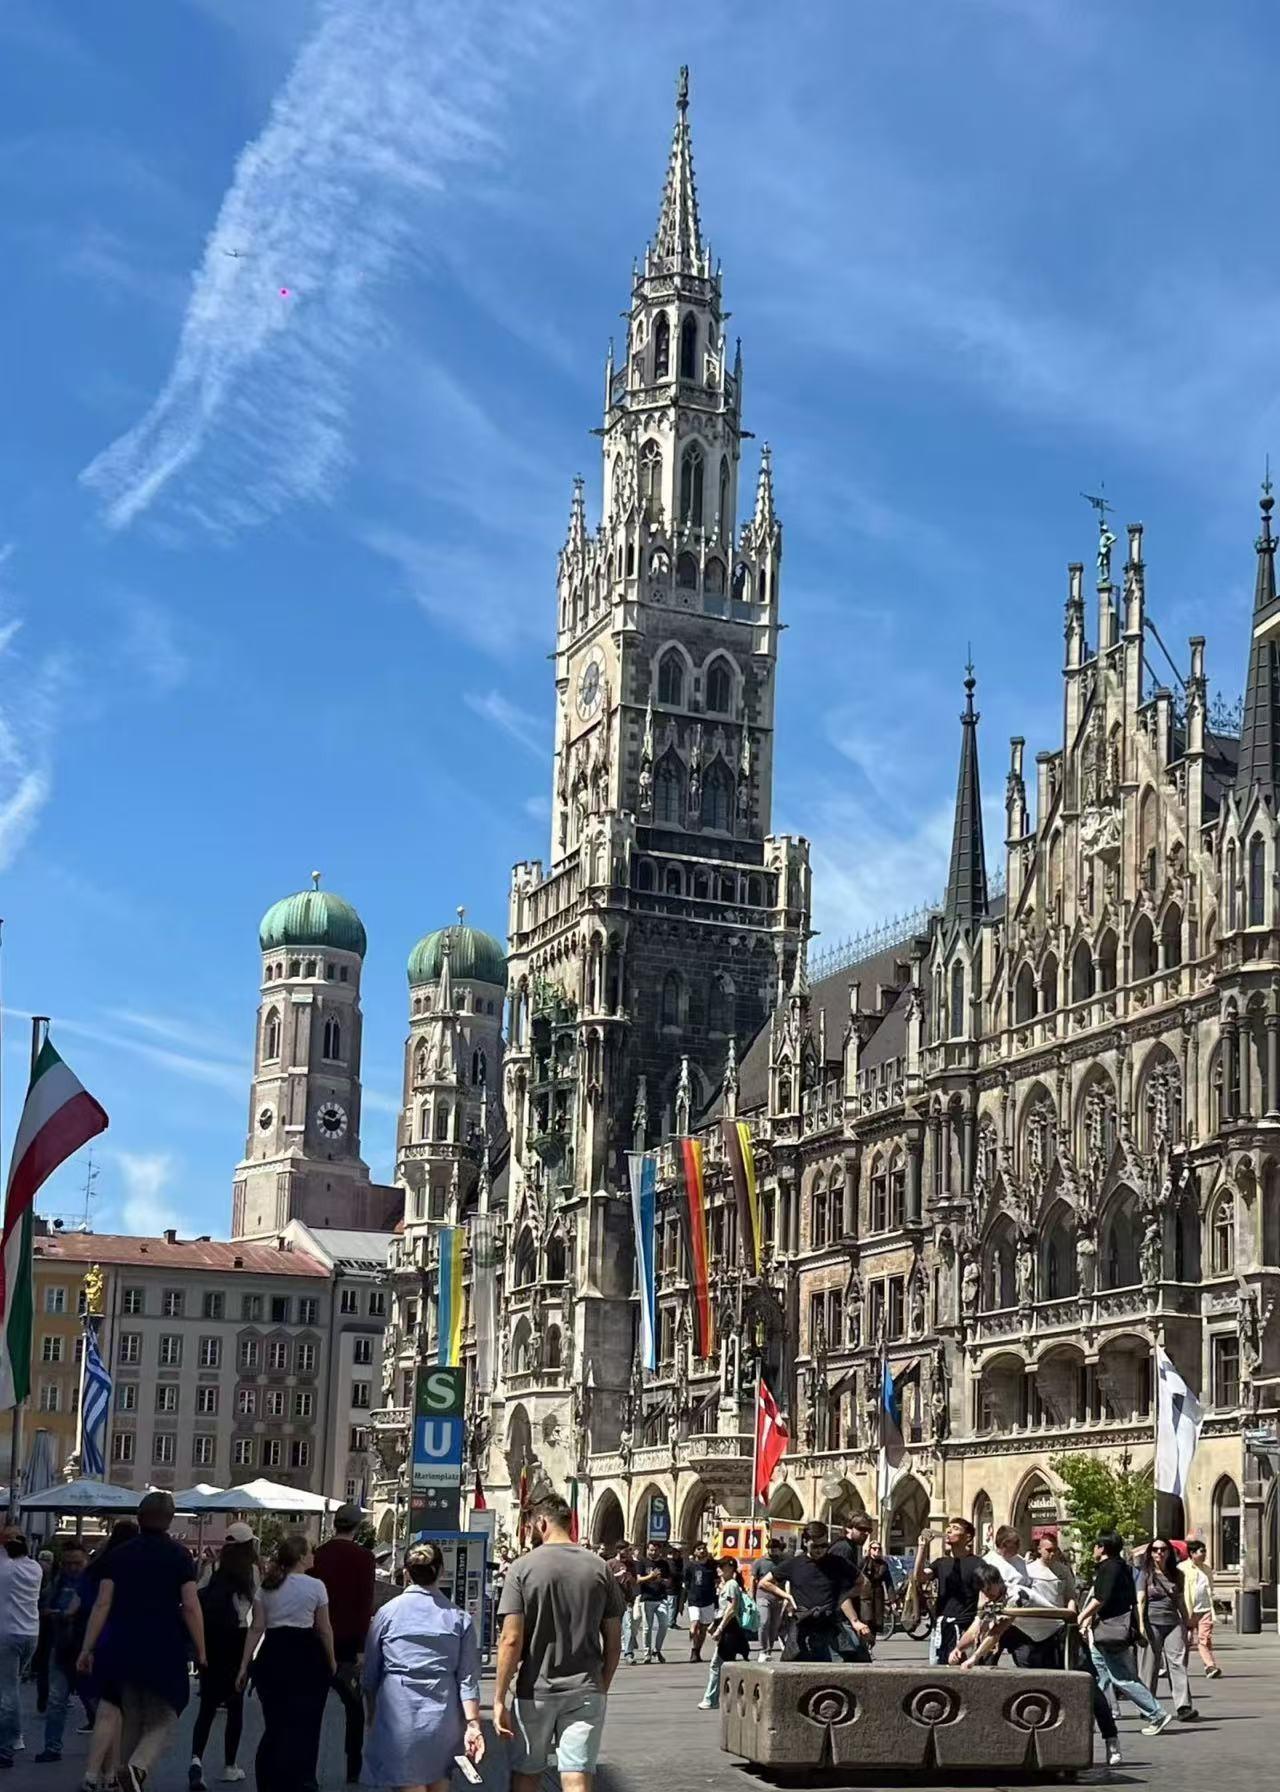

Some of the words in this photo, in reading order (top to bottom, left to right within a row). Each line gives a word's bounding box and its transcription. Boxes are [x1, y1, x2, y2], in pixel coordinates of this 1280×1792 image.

[426, 1372, 455, 1409] S
[424, 1421, 452, 1457] U
[414, 1471, 460, 1481] Marienplatz
[653, 1497, 665, 1511] S
[653, 1514, 664, 1529] U
